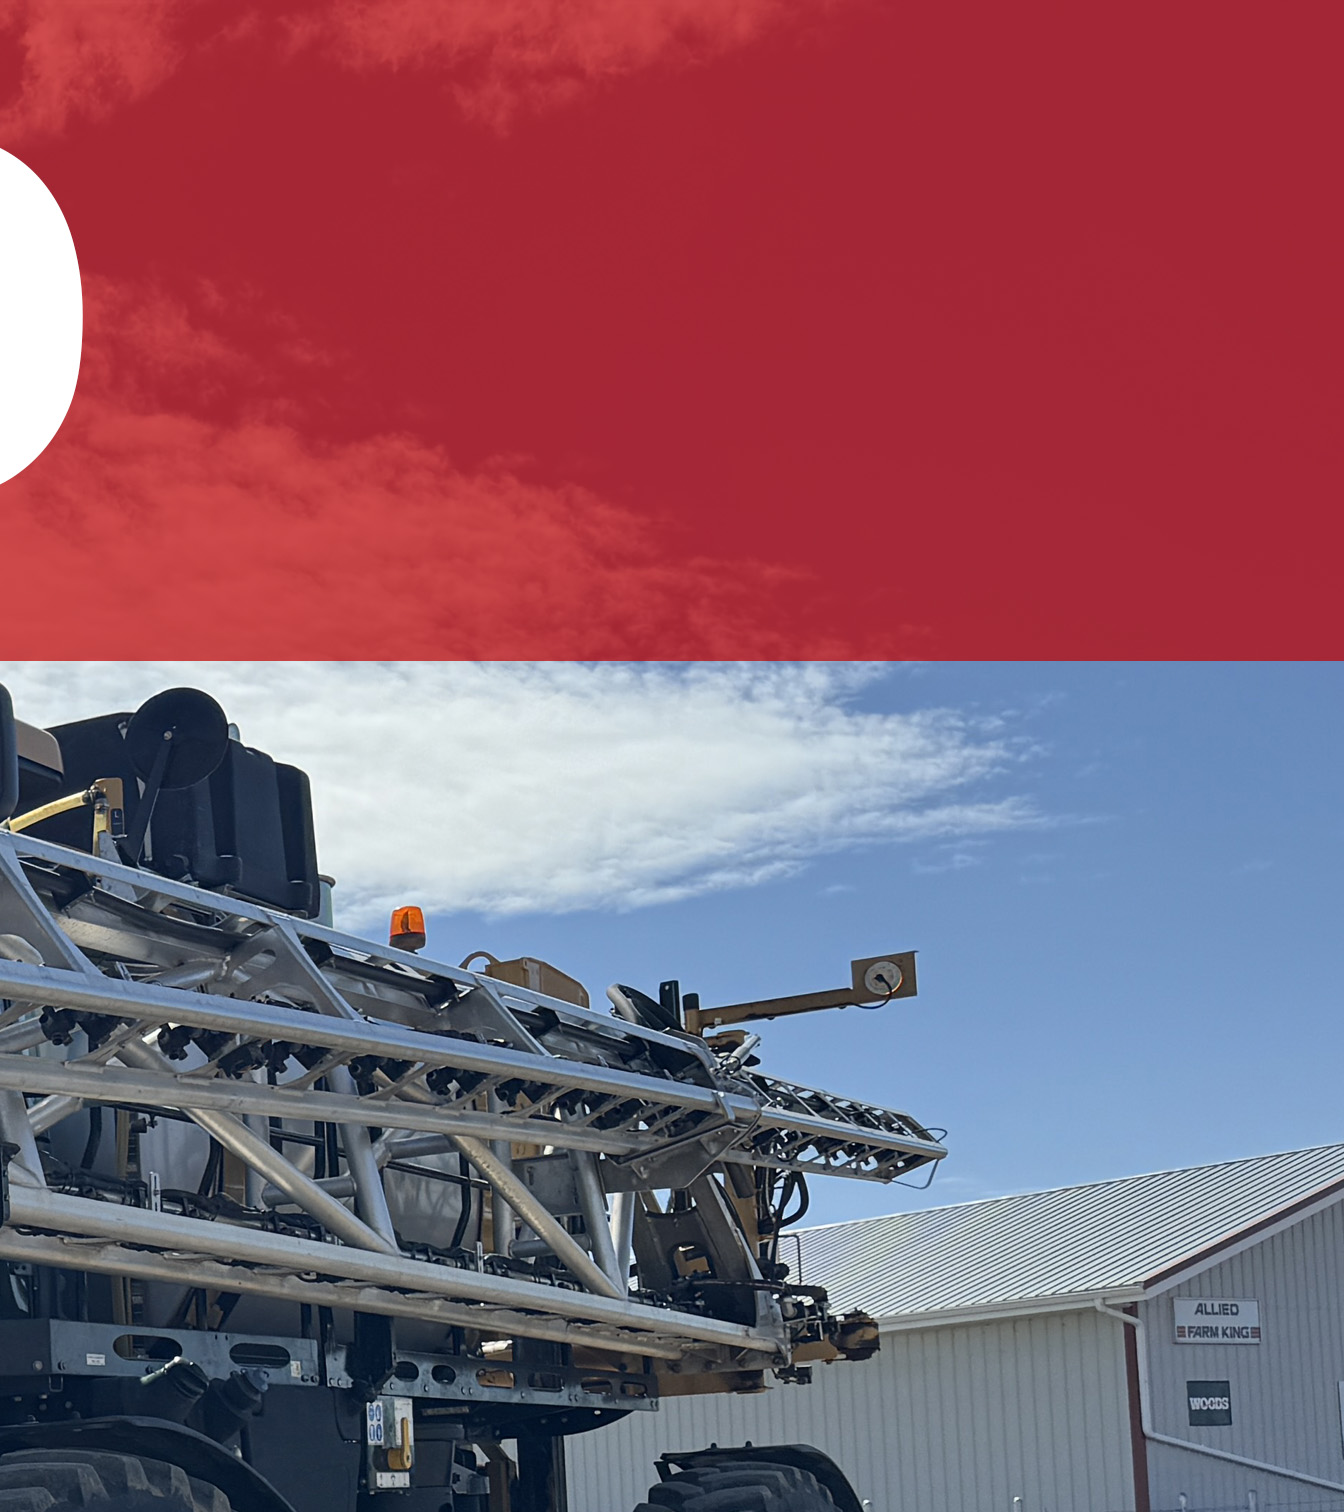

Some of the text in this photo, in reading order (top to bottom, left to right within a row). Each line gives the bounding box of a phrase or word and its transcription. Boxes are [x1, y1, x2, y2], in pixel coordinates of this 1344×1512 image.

[1194, 1302, 1239, 1316] ALLIED
[1187, 1326, 1249, 1339] FARM KING
[1189, 1397, 1229, 1410] WOODS
